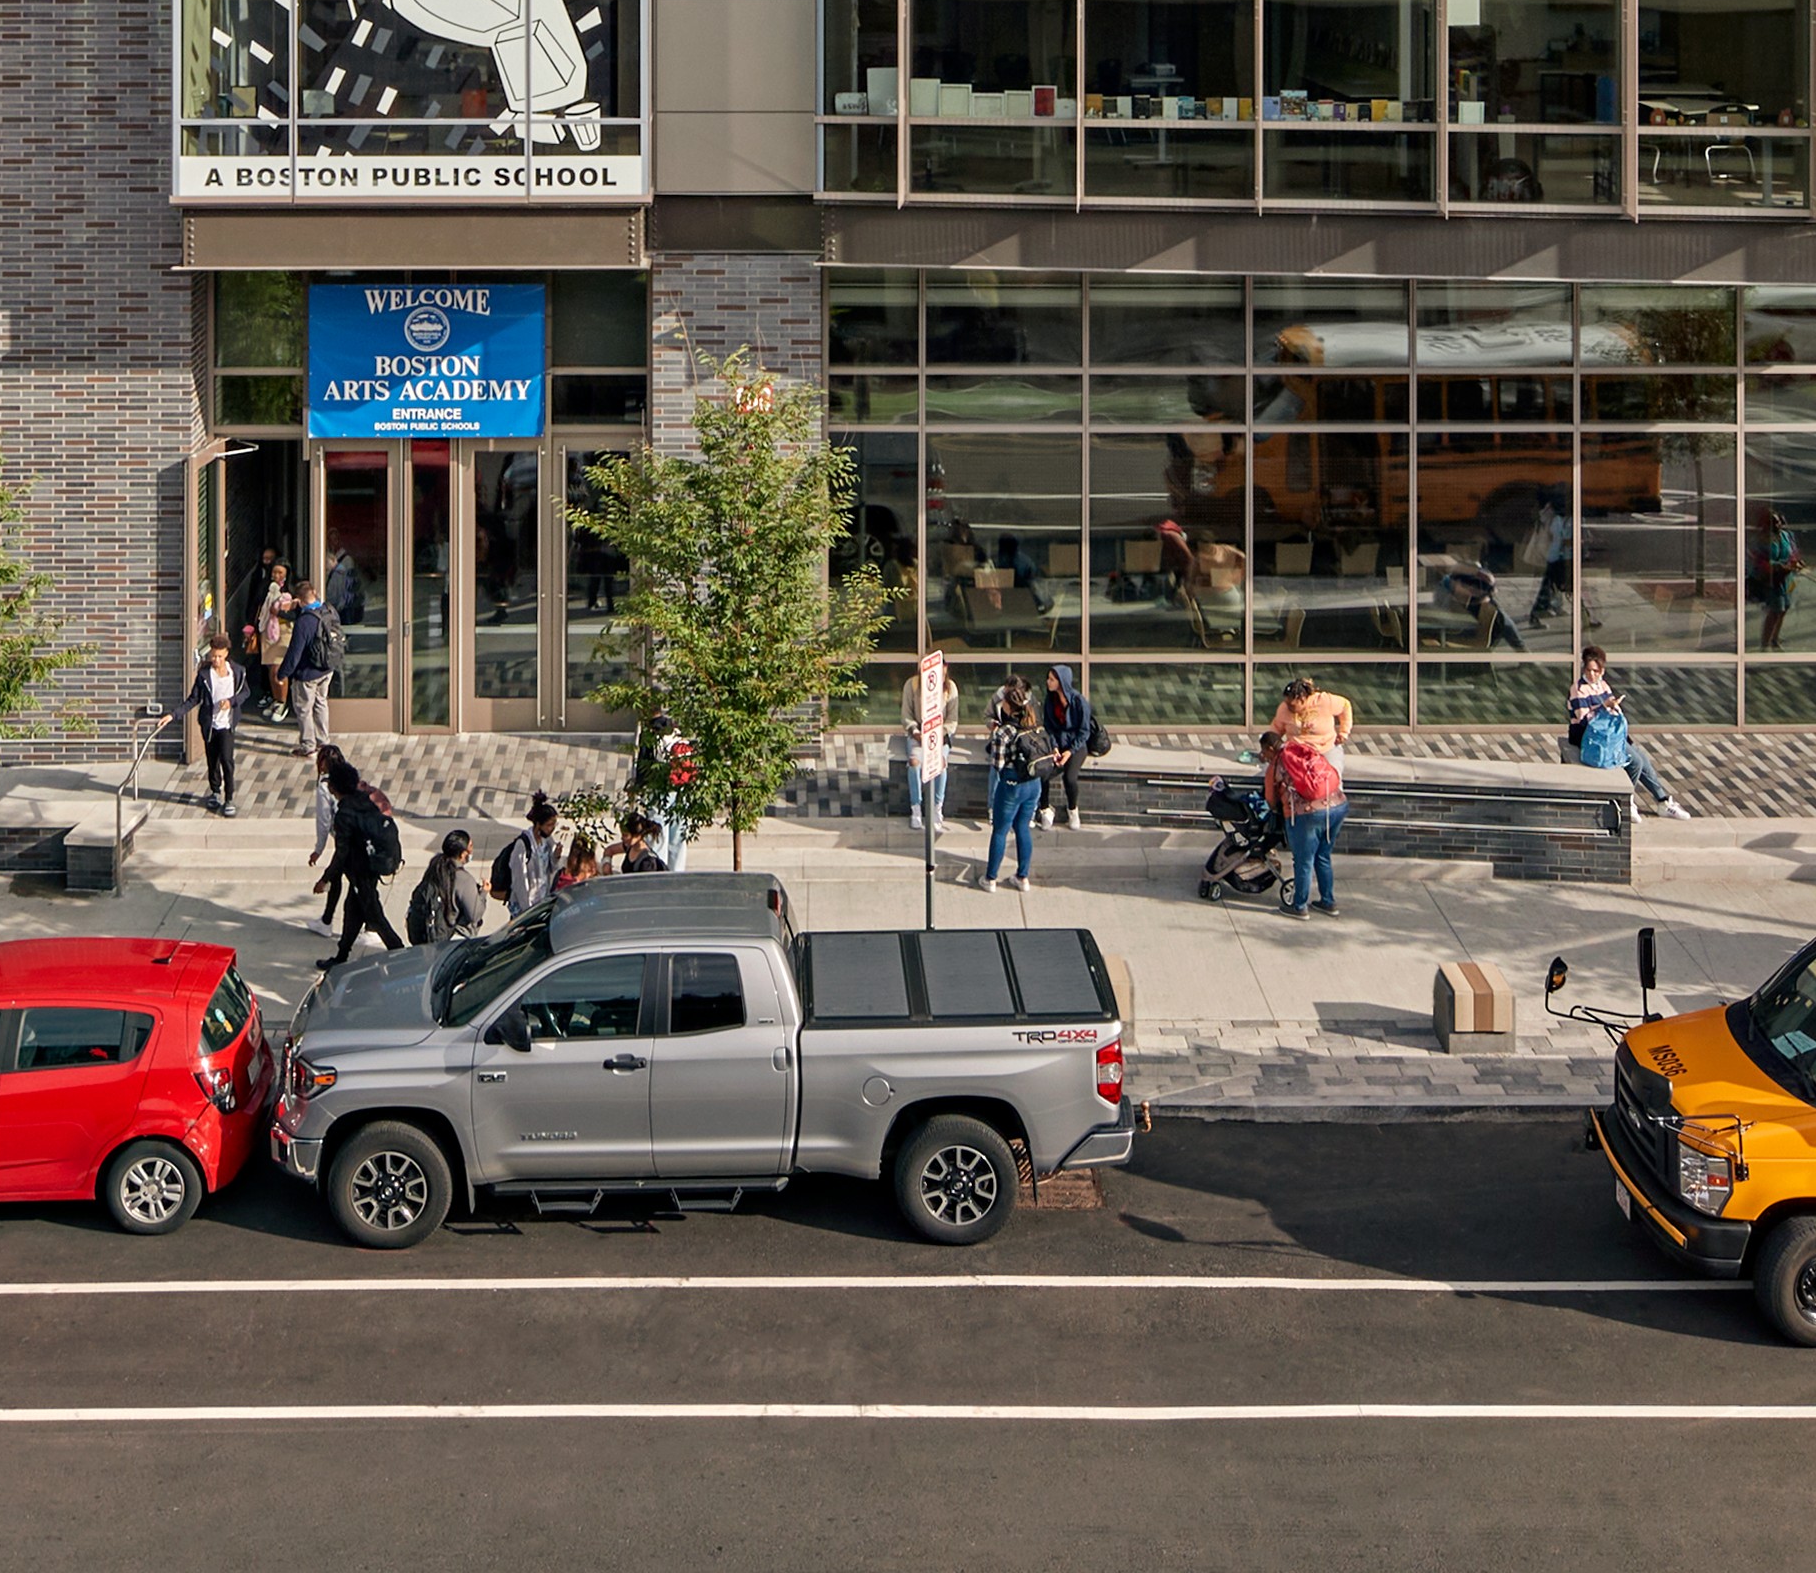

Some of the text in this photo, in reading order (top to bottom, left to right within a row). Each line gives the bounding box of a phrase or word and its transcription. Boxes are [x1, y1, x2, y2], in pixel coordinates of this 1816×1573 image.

[204, 167, 618, 187] A BOSTON PUBLIC SCHOOL
[365, 288, 490, 316] WELCOME
[374, 355, 481, 377] BOSTON
[323, 379, 532, 401] ARTS ACADEMY
[392, 408, 462, 421] ENTRANCE
[374, 422, 481, 431] BOSTON PUBLIC SCHOOLS
[1647, 1044, 1688, 1078] MS036
